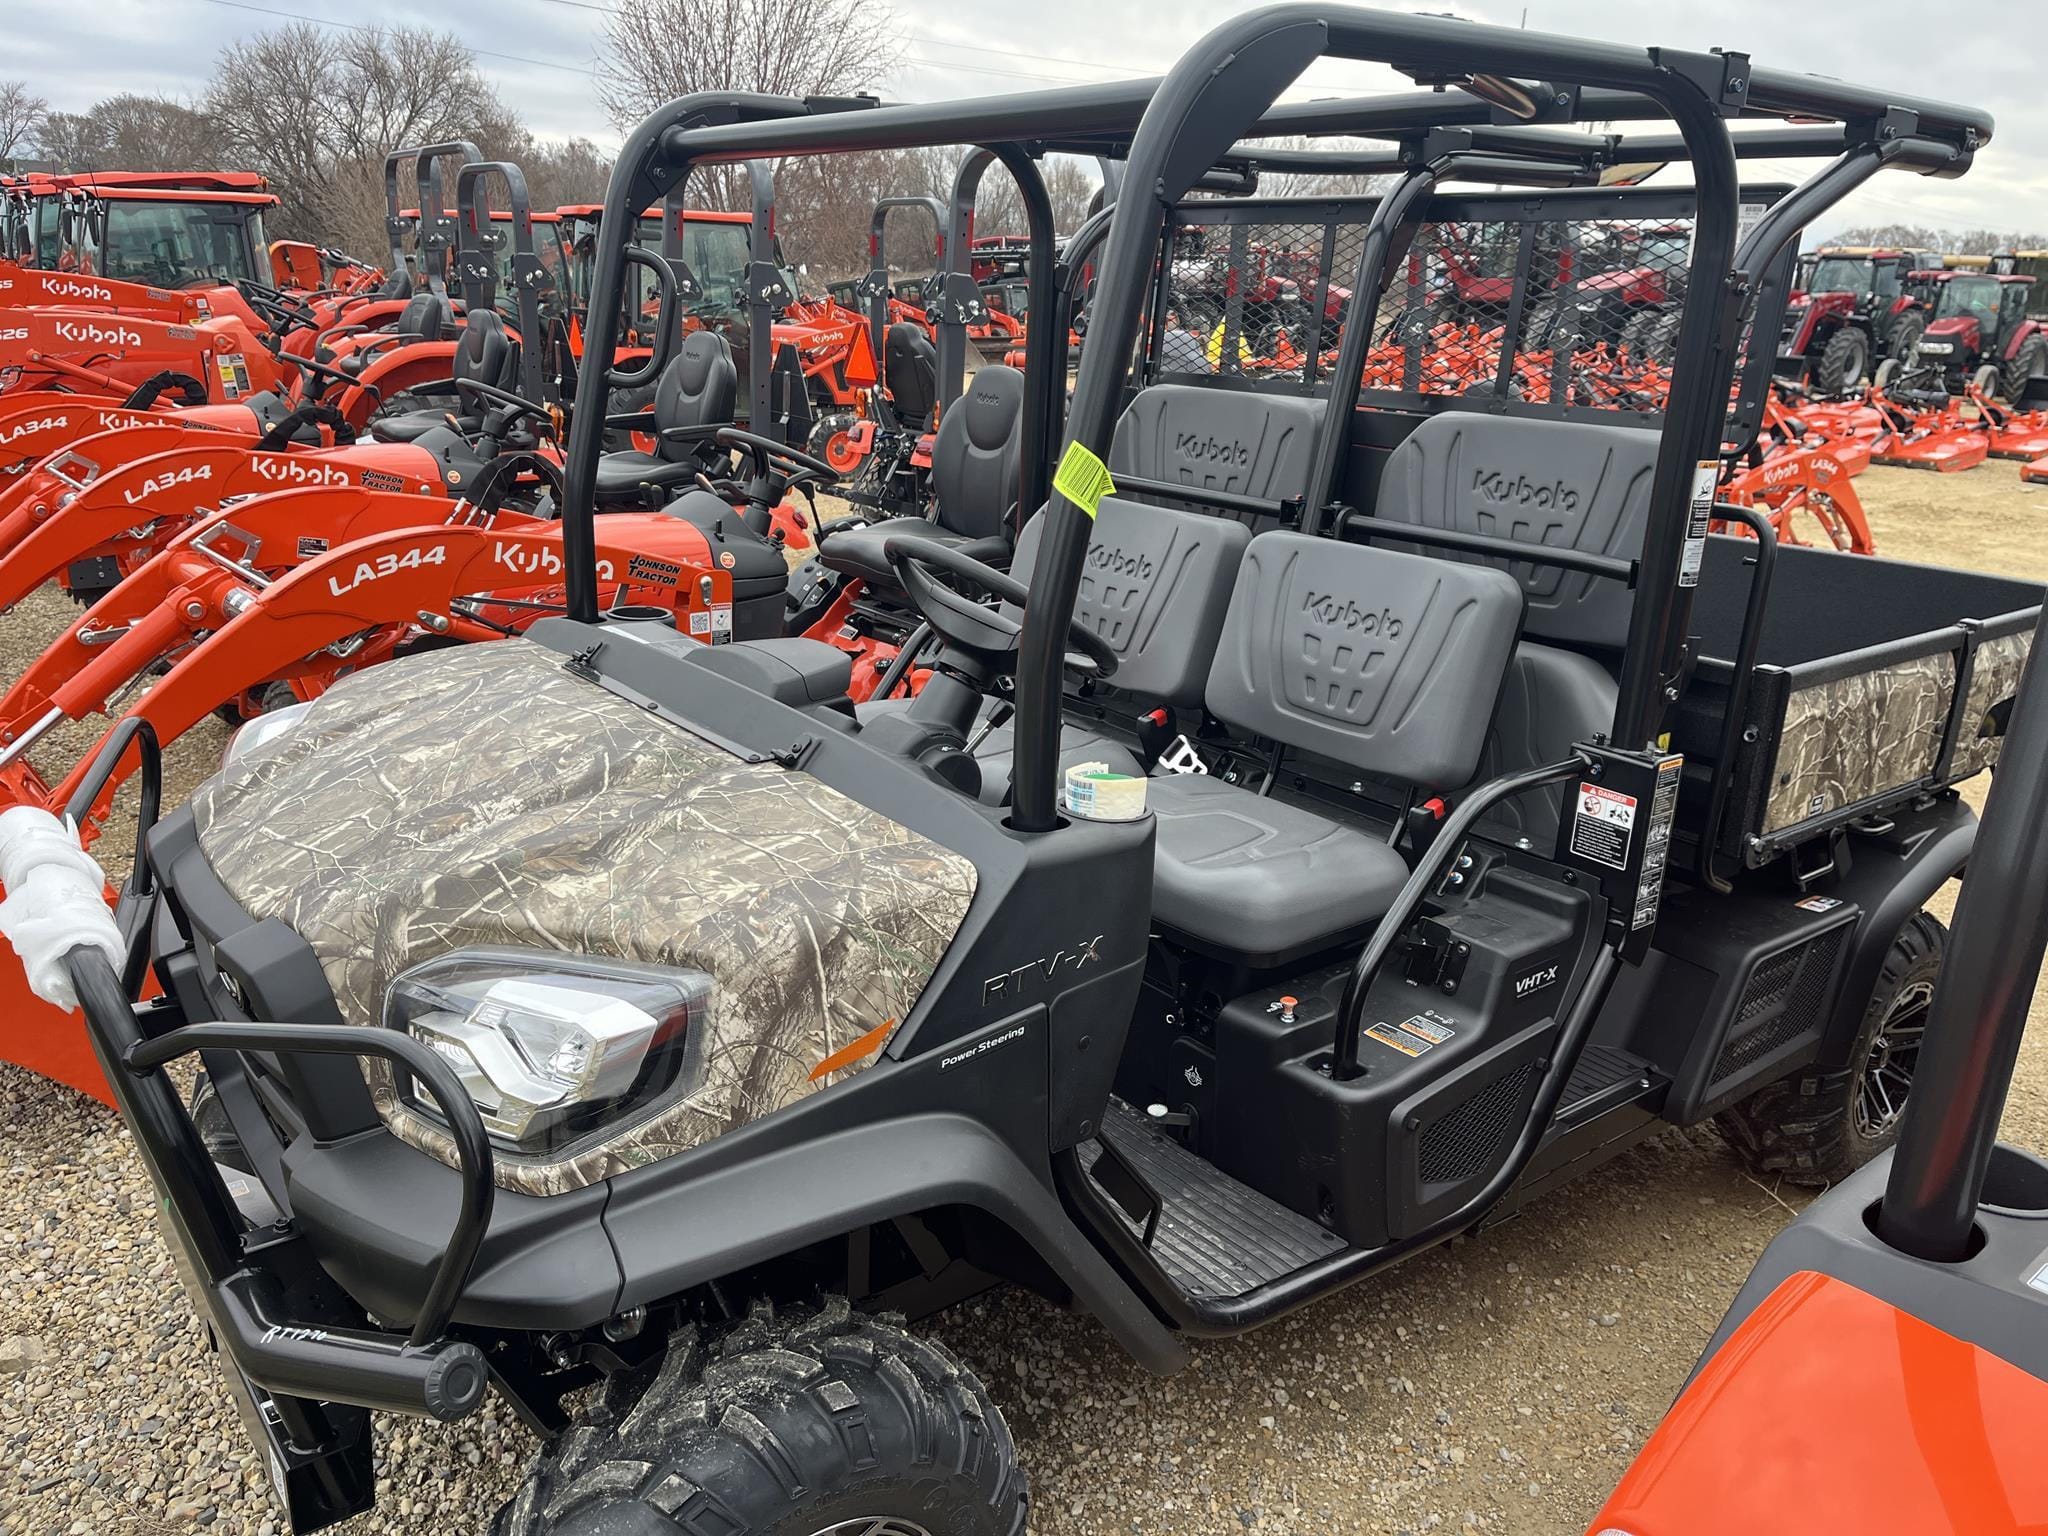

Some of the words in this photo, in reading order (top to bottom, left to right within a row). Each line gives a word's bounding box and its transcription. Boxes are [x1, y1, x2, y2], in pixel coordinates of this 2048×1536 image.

[42, 277, 112, 301] Kubota
[0, 327, 29, 341] 26
[56, 321, 142, 347] Kubota
[811, 331, 845, 345] Kubota
[0, 415, 68, 445] LA344
[1175, 432, 1249, 469] Kubota
[123, 464, 213, 505] LA344
[251, 456, 350, 487] Kubota
[361, 469, 404, 485] JOHNSON
[361, 476, 402, 493] TRACTOR
[1762, 461, 1799, 485] Kubota
[1472, 469, 1580, 515] Kubota
[327, 545, 446, 598] LA344
[494, 541, 615, 581] Kuba
[628, 565, 677, 585] TRACTOR
[629, 554, 681, 575] JOHNSON
[1301, 591, 1404, 643] Kubota
[1597, 788, 1628, 804] DANGER
[983, 934, 1104, 1007] RTV-X
[1516, 965, 1559, 993] VHT-X
[940, 1046, 978, 1069] Power
[978, 1025, 1026, 1053] Steering
